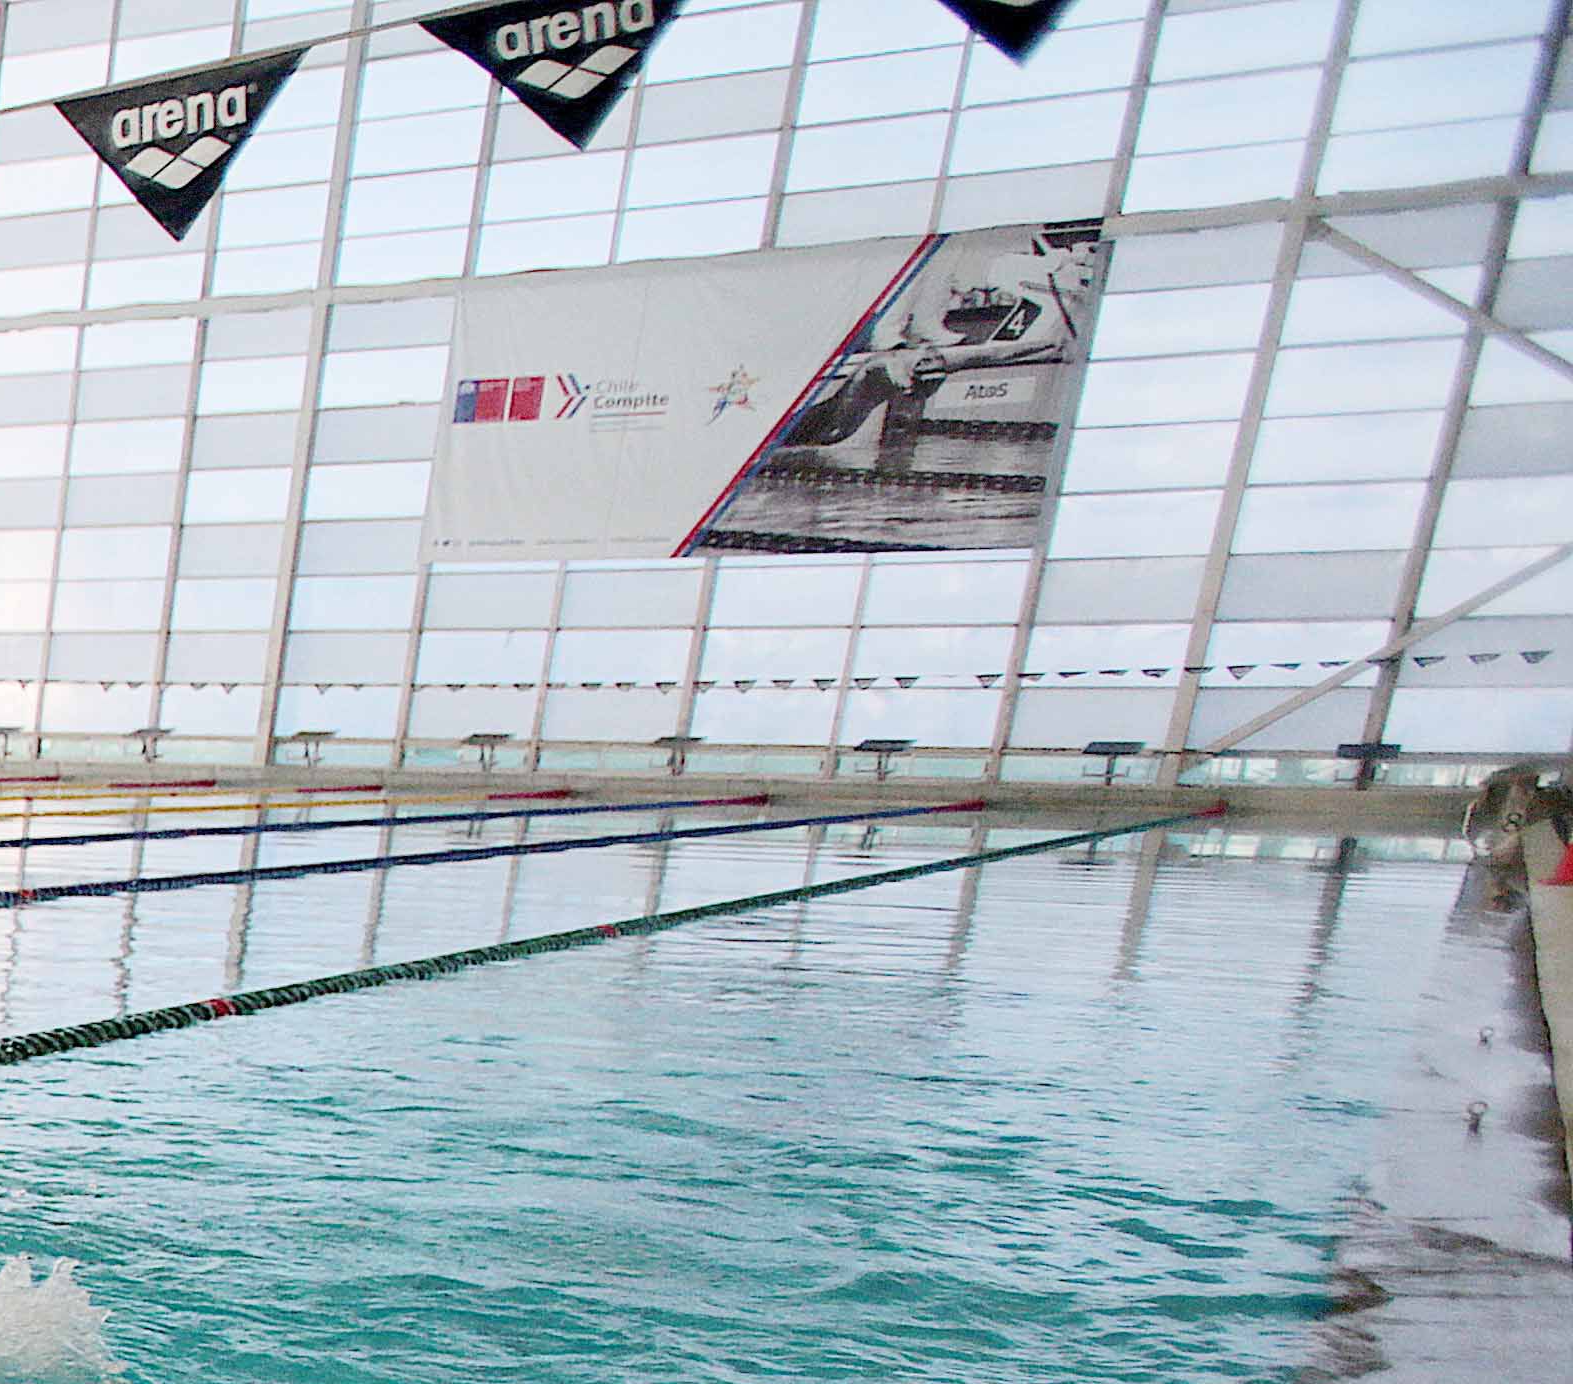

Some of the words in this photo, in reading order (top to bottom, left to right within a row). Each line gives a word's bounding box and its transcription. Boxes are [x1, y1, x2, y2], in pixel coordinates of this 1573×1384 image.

[494, 0, 655, 62] arena
[111, 85, 249, 148] arena
[1007, 308, 1027, 336] 4
[592, 392, 670, 411] Compite
